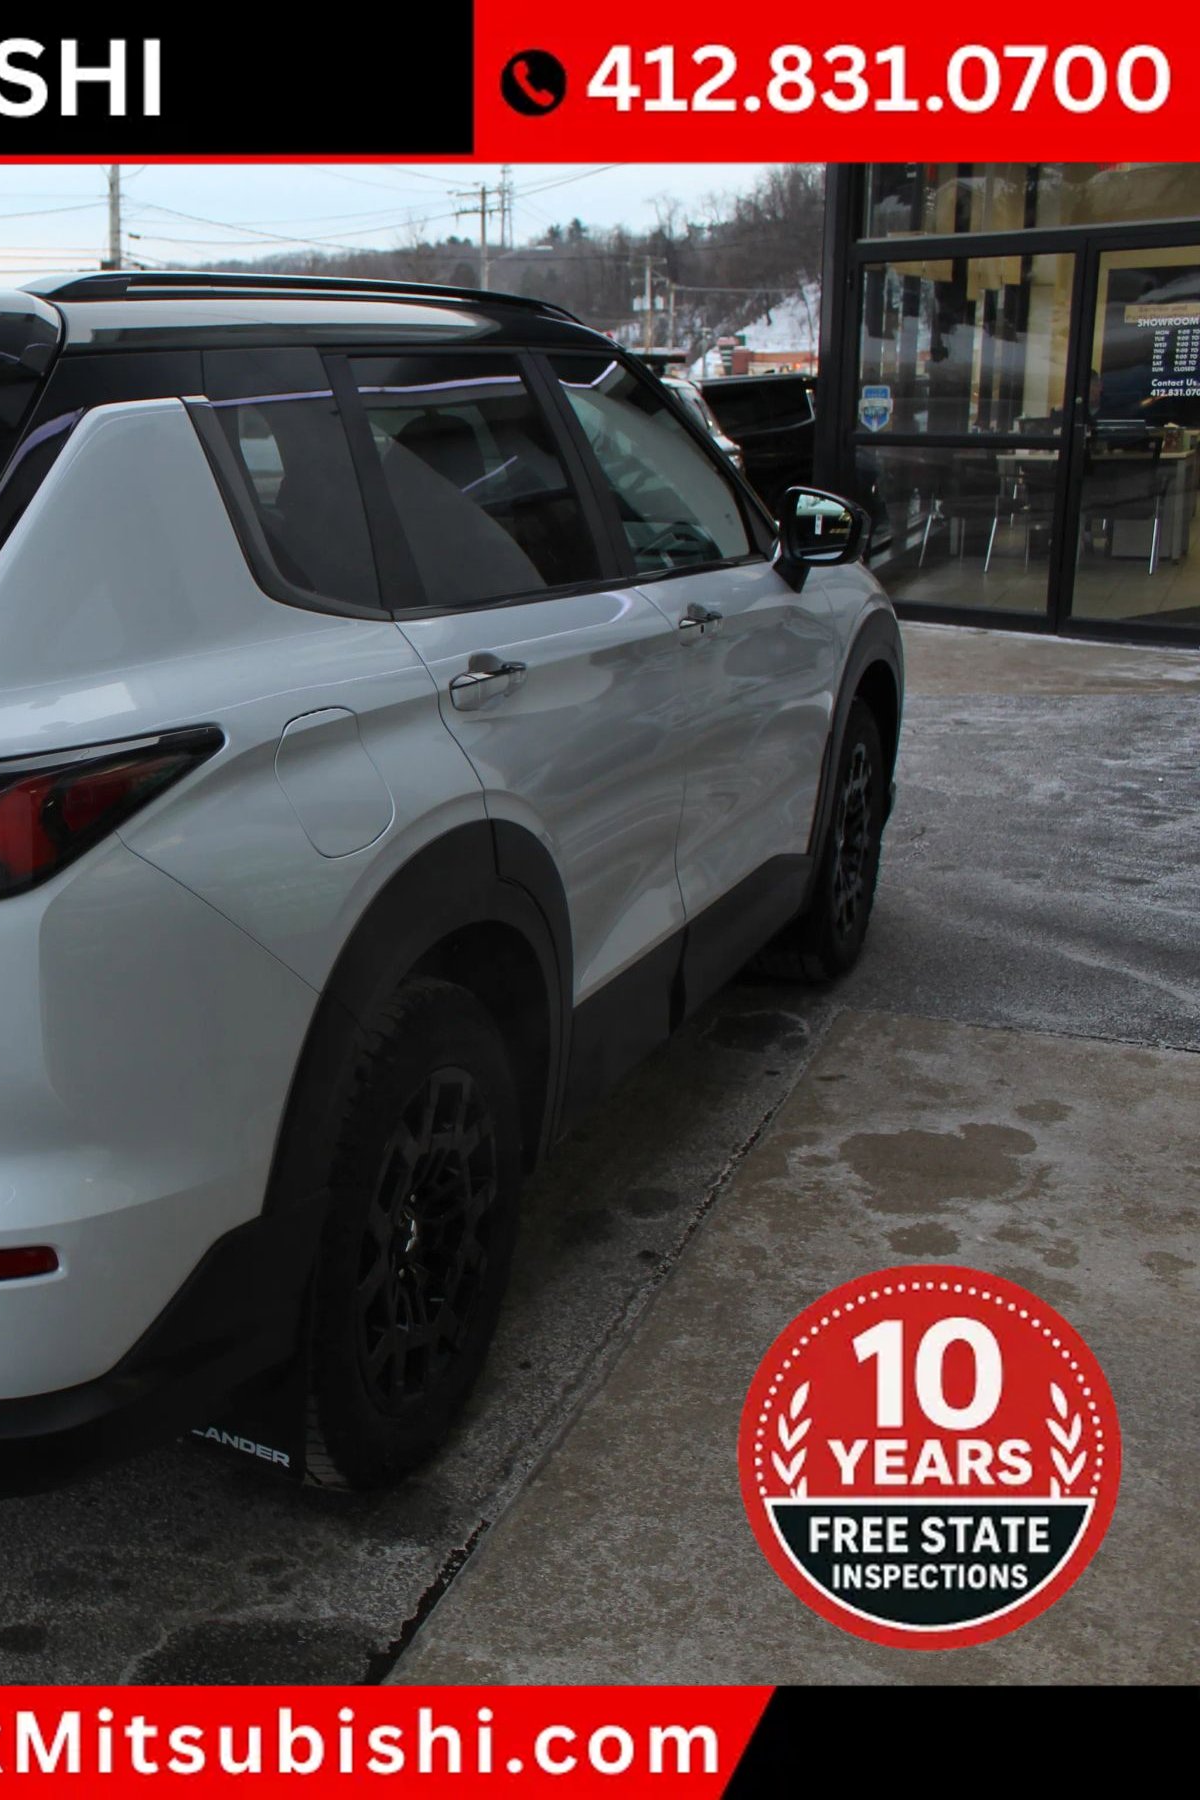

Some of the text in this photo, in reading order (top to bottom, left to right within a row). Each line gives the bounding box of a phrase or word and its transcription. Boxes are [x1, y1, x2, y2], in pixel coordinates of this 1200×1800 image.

[1137, 317, 1199, 327] SHOWROOM
[1151, 379, 1184, 387] Contact
[191, 1427, 291, 1468] ANDER
